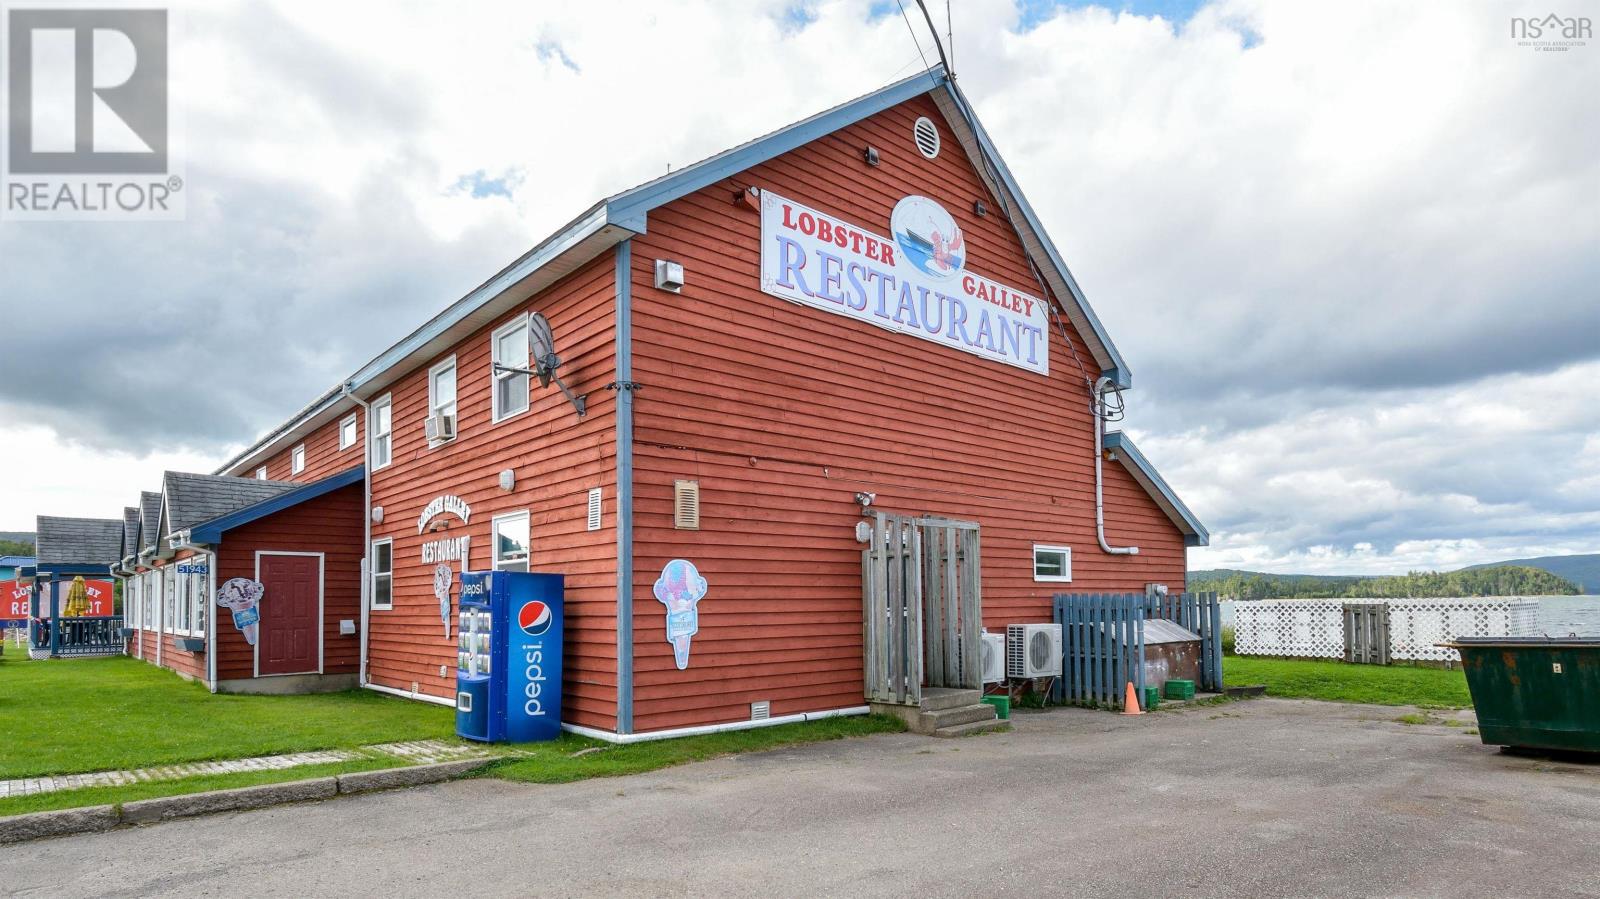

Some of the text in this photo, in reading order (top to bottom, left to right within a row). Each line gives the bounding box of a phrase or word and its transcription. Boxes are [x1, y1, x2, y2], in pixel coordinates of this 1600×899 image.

[782, 205, 1034, 317] LOBSTER GALLEY
[775, 235, 1042, 365] RESTAURANT
[444, 495, 471, 525] GALLEY
[178, 565, 208, 573] 51943
[463, 581, 483, 597] pepsi
[522, 641, 546, 717] pepsi
